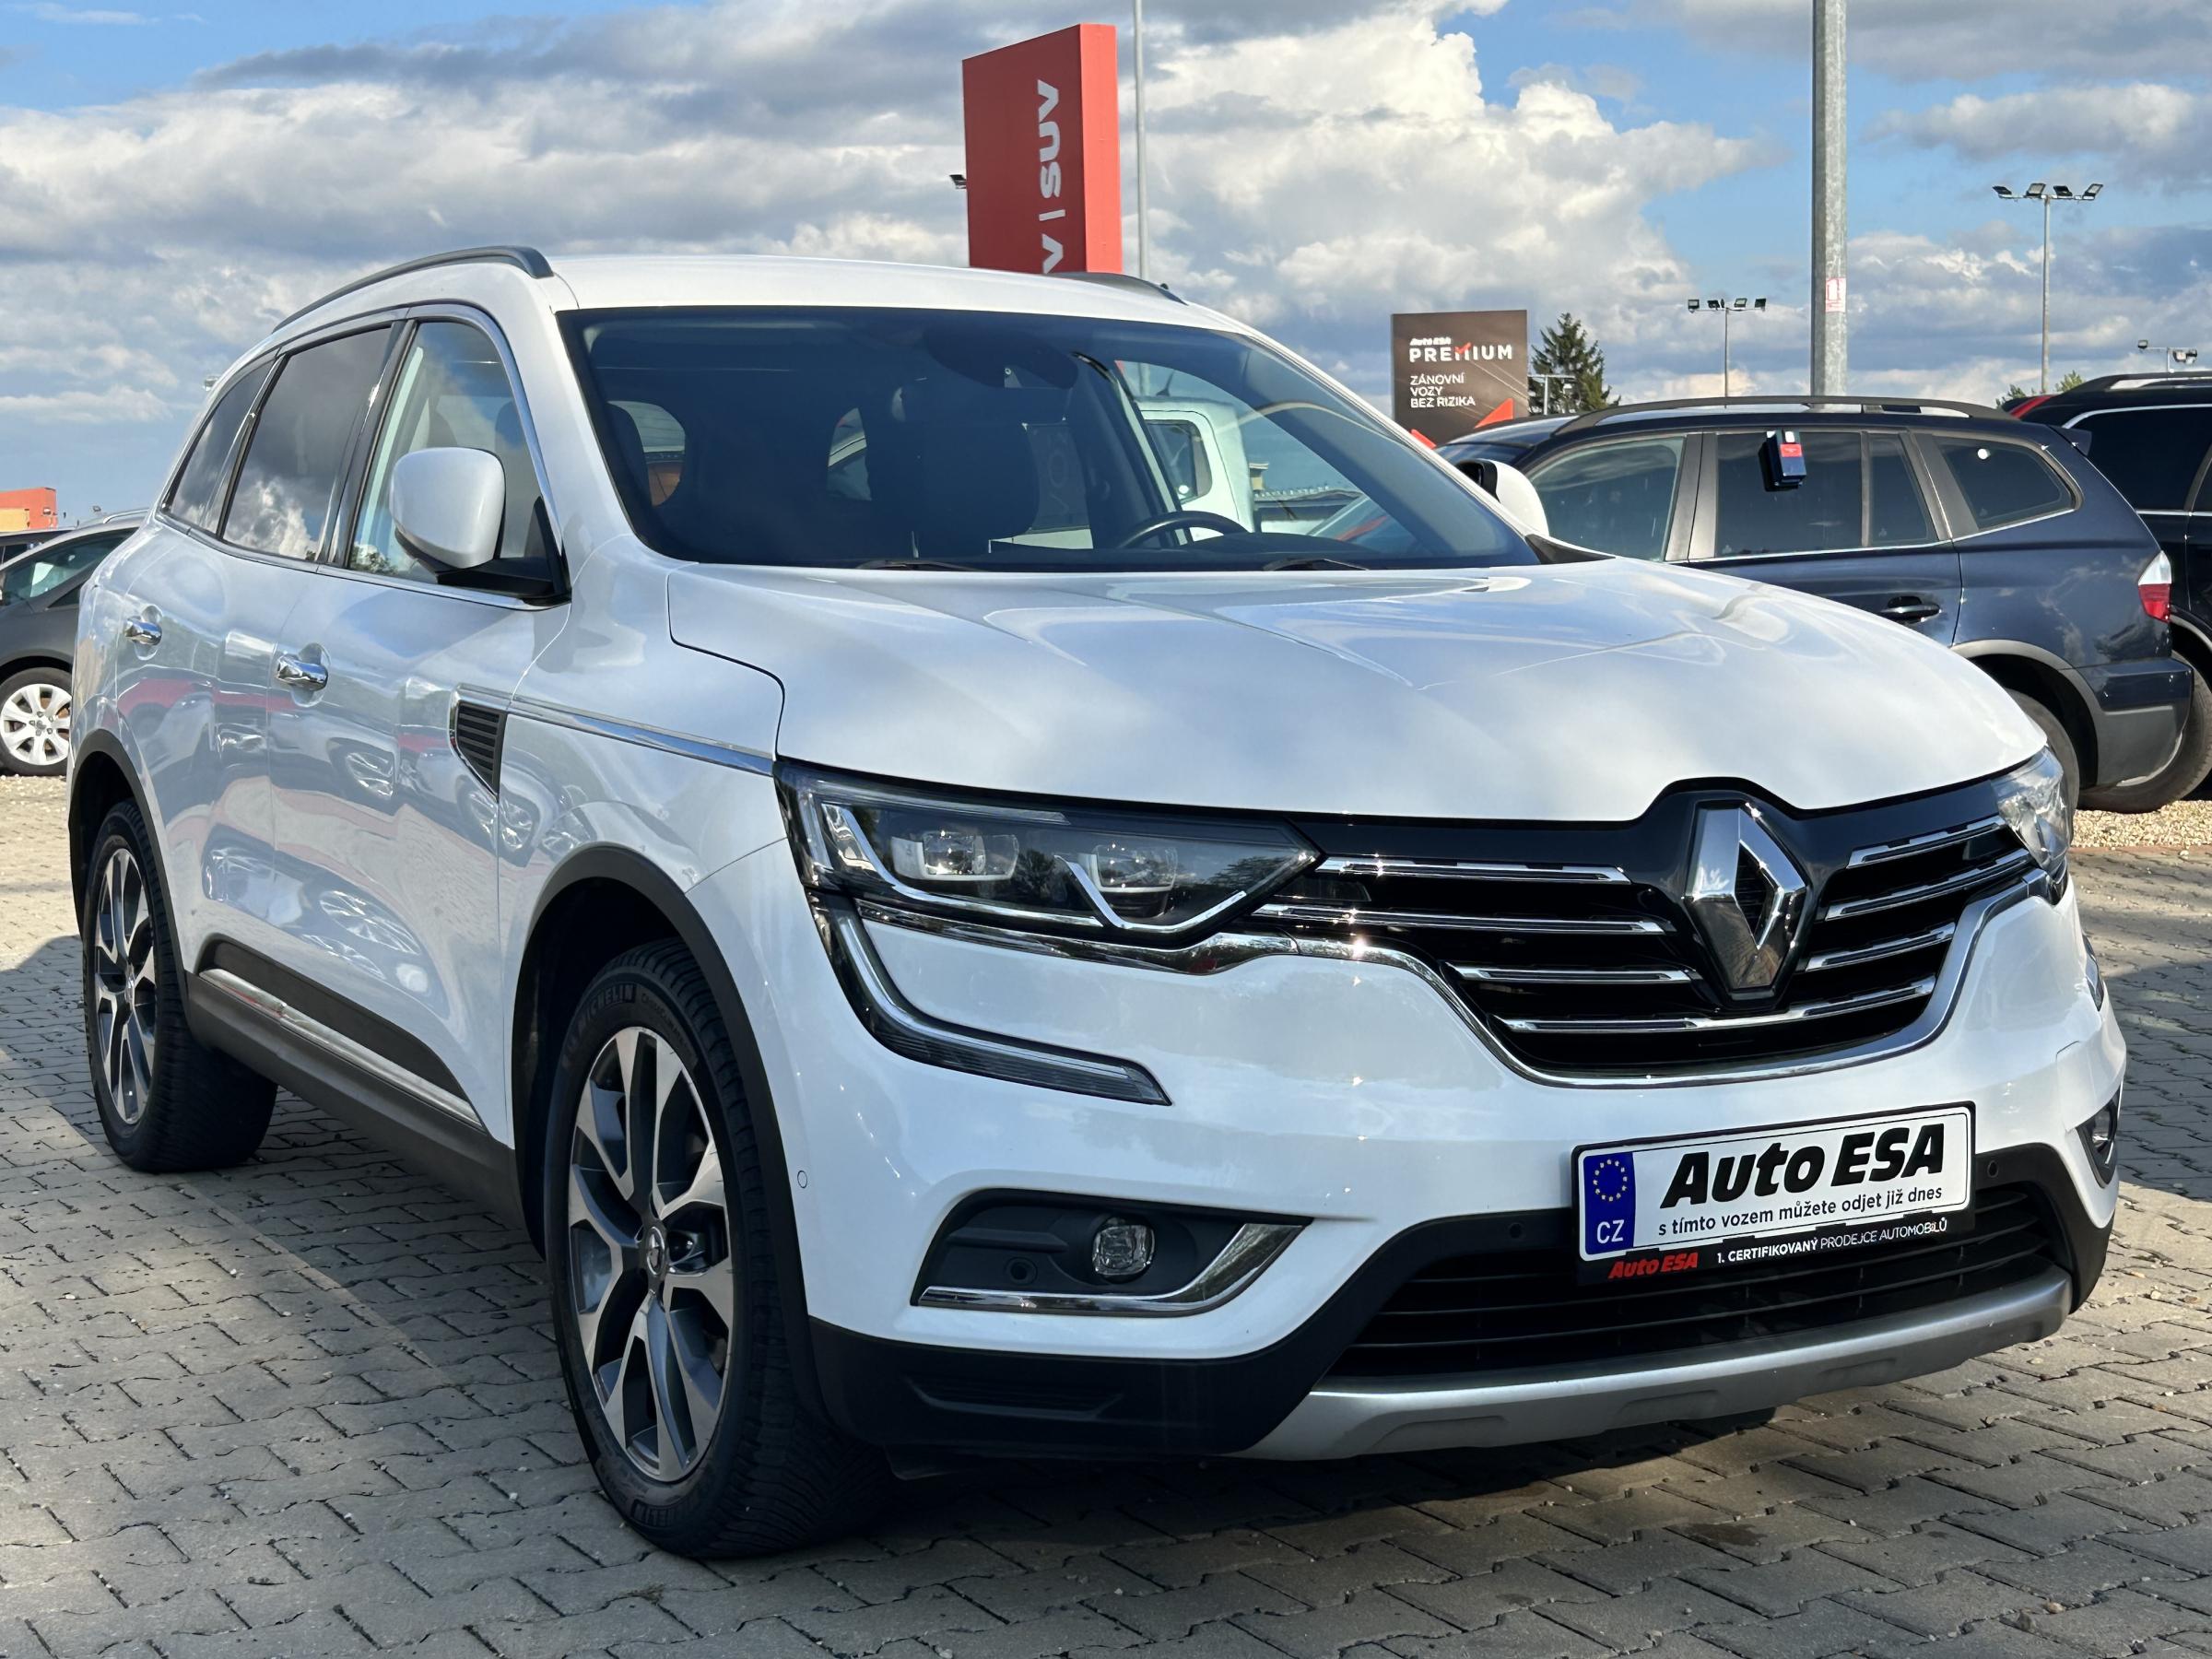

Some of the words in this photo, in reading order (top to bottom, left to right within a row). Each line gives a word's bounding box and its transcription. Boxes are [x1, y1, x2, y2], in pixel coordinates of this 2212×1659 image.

[1037, 79, 1062, 199] SUV
[1409, 342, 1512, 362] PREMIUM
[1410, 372, 1465, 385] ZÁNOVNÍ
[1410, 387, 1443, 396] VOZY
[1410, 398, 1435, 408] BEZ
[1437, 396, 1477, 406] RIZIKA
[1660, 1142, 1825, 1209] Auto
[1830, 1123, 1945, 1187] ESA
[1658, 1223, 1666, 1236] s
[1672, 1217, 1716, 1235] tímto
[1721, 1207, 1773, 1228] vozem
[1779, 1200, 1837, 1219] můžete
[1841, 1191, 1882, 1213] odjet
[1885, 1188, 1904, 1209] již
[1908, 1186, 1942, 1203] dnes
[1596, 1219, 1624, 1243] CZ
[1717, 1252, 1726, 1264] 1.
[1728, 1238, 1818, 1263] CERTIFIKOVANÝ
[1820, 1230, 1878, 1250] PRODEJCE
[1608, 1259, 1658, 1279] Auto
[1660, 1252, 1699, 1273] ESA
